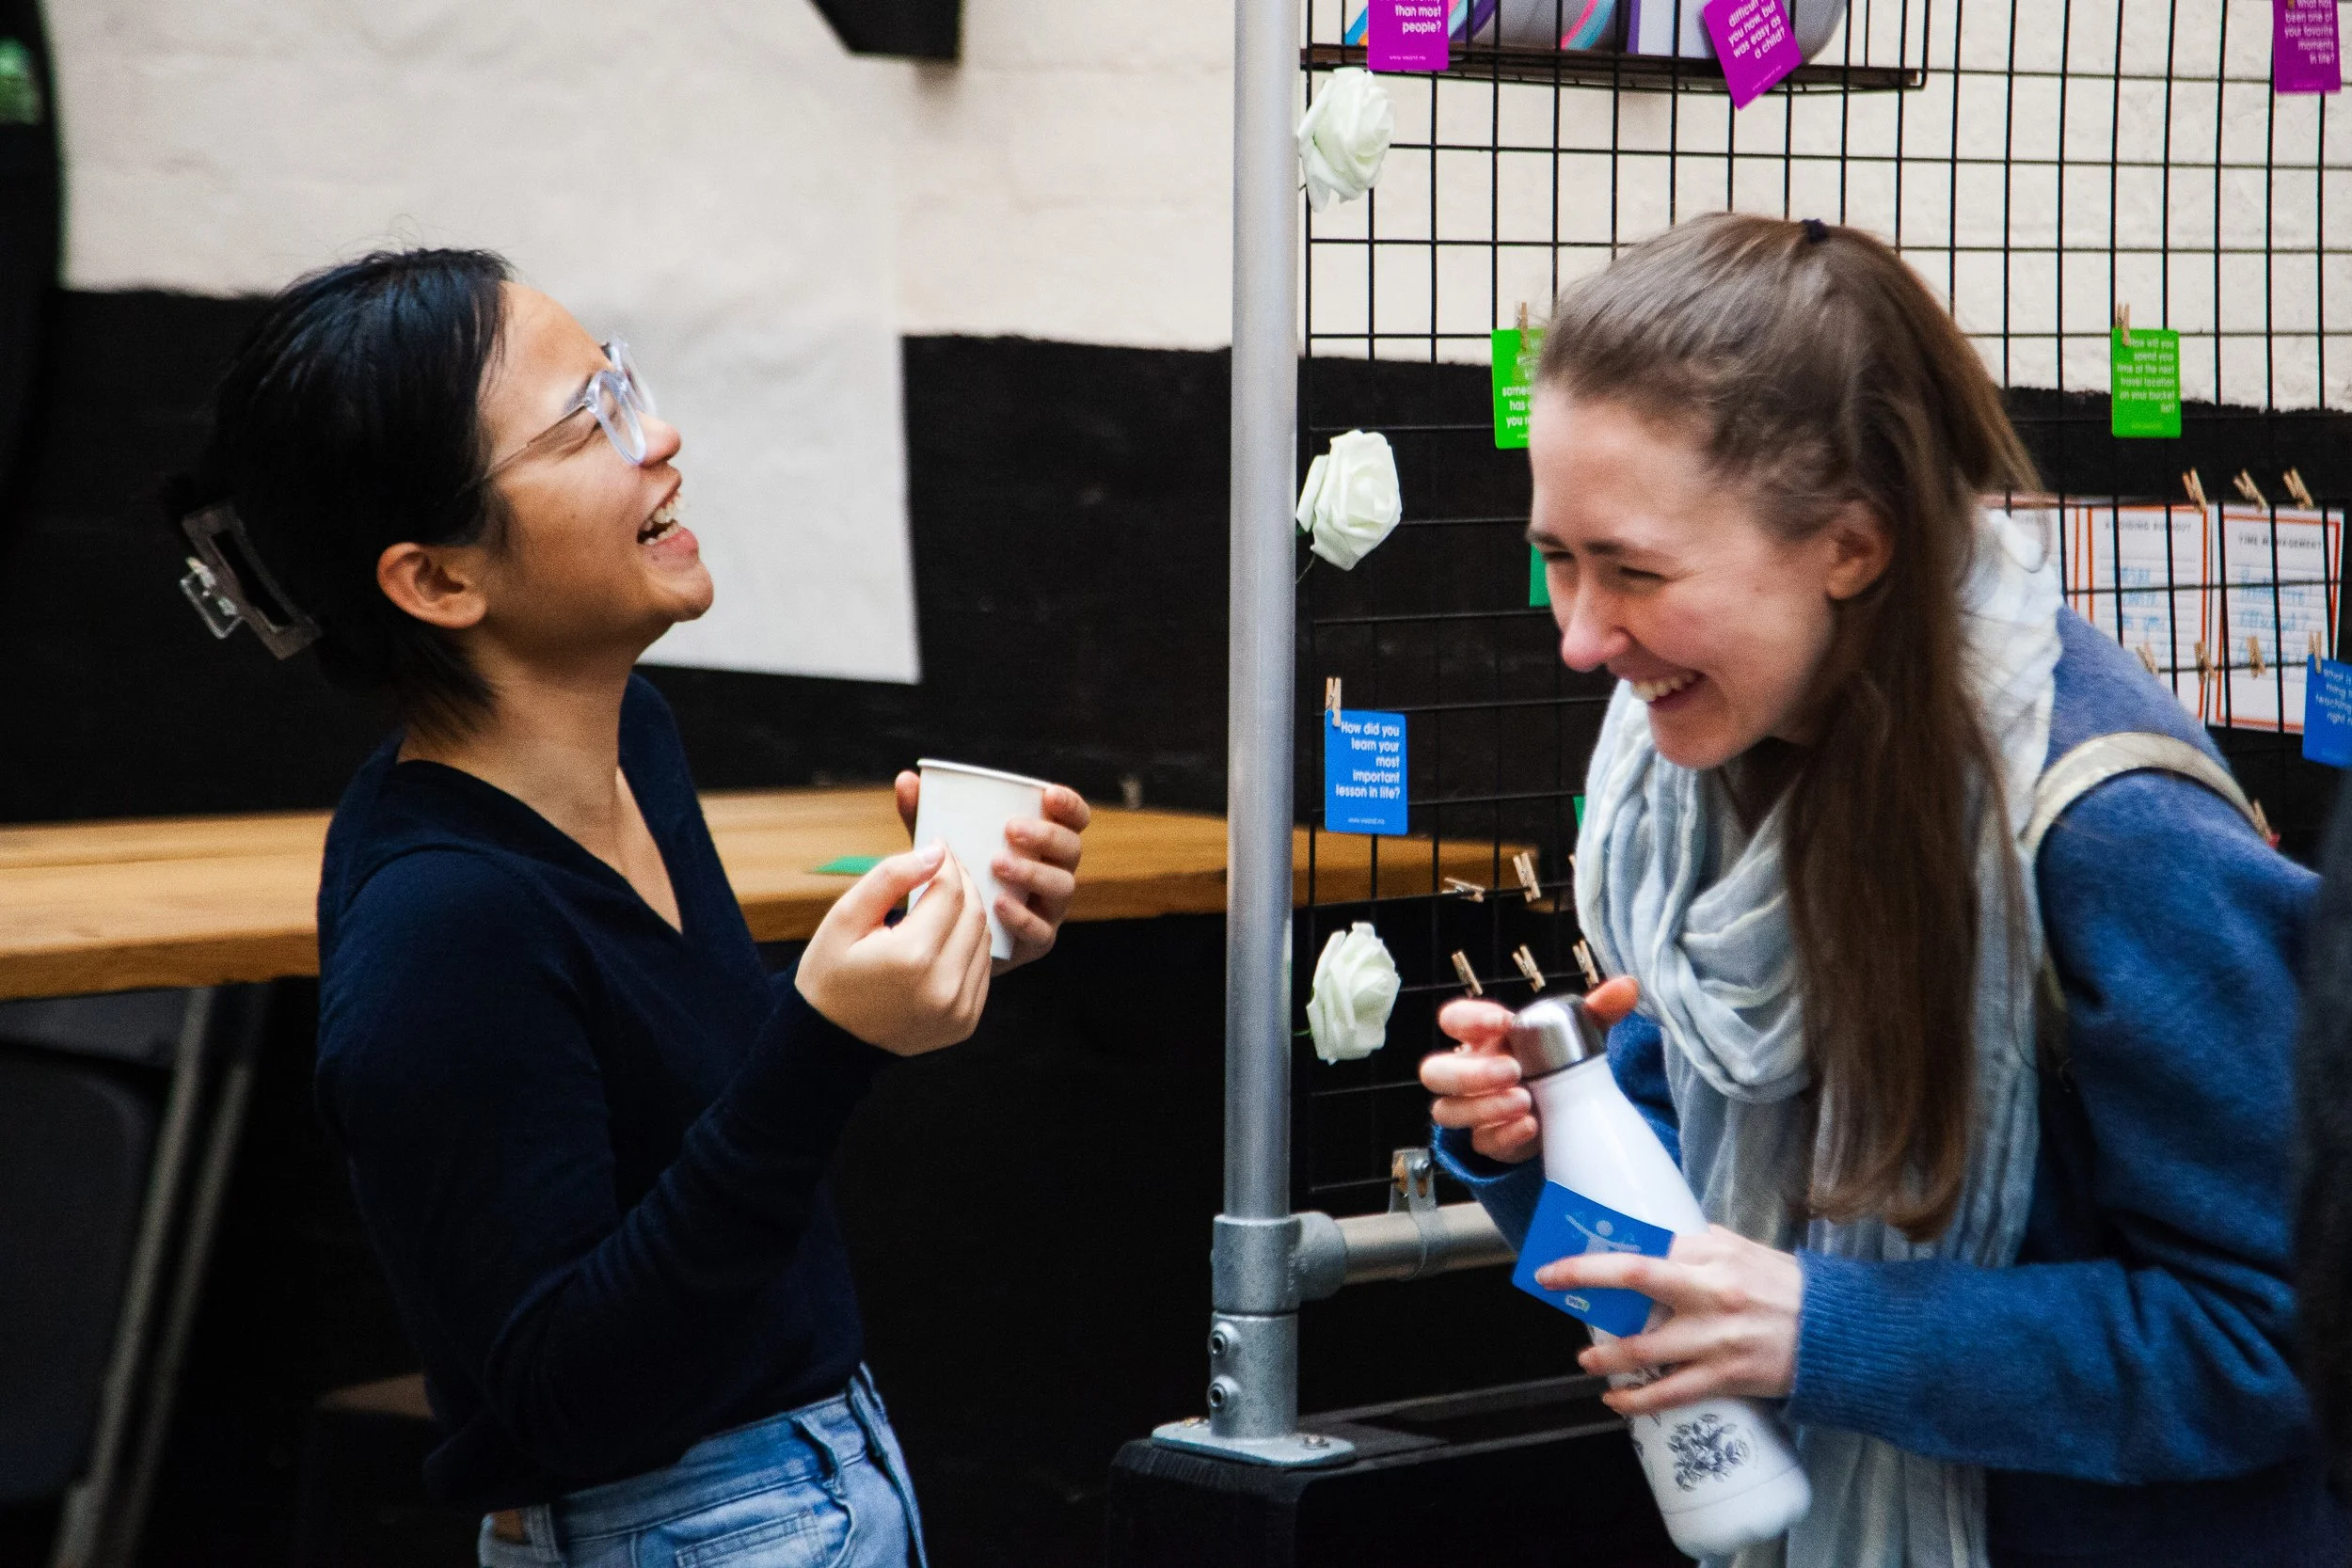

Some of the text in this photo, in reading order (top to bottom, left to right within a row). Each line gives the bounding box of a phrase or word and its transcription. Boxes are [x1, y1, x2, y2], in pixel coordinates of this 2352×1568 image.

[1394, 4, 1441, 18] than most
[2284, 9, 2334, 24] been one of
[1402, 20, 1442, 35] people?
[1727, 0, 1776, 48] you now, but
[2284, 24, 2334, 39] your favorite
[1733, 14, 1782, 58] was easy as
[1754, 24, 1785, 59] a child?
[2297, 40, 2334, 51] moments
[1509, 400, 1526, 412] has
[1506, 416, 1524, 429] you
[2261, 534, 2323, 551] MNAGEMENT
[1341, 721, 1400, 738] How did you
[1351, 736, 1400, 753] learn your
[1375, 755, 1400, 768] most
[1352, 769, 1400, 784] important
[1335, 784, 1401, 800] lesson in life?
